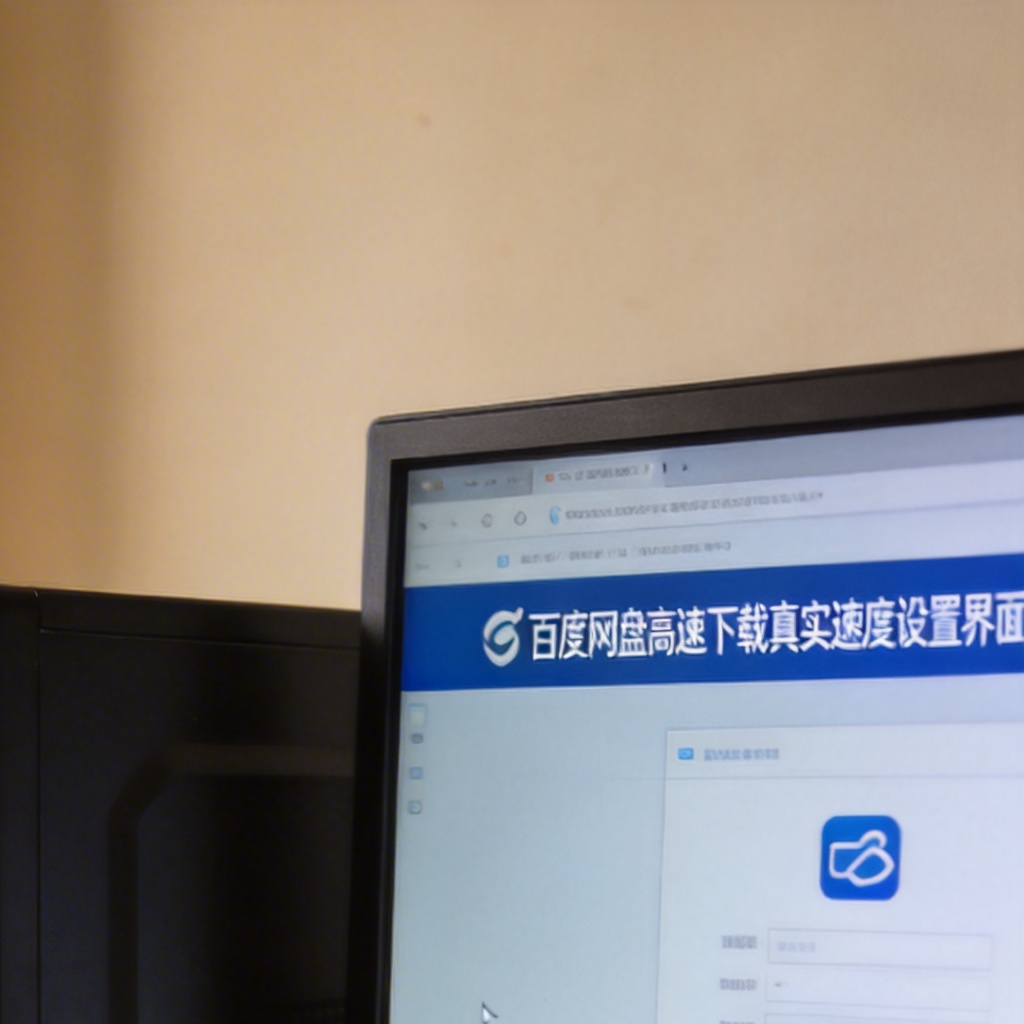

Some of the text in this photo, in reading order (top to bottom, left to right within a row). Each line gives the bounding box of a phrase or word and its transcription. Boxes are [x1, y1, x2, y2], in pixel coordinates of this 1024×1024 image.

[528, 591, 1024, 661] 百度网盘高速下载真实速度设置界面
